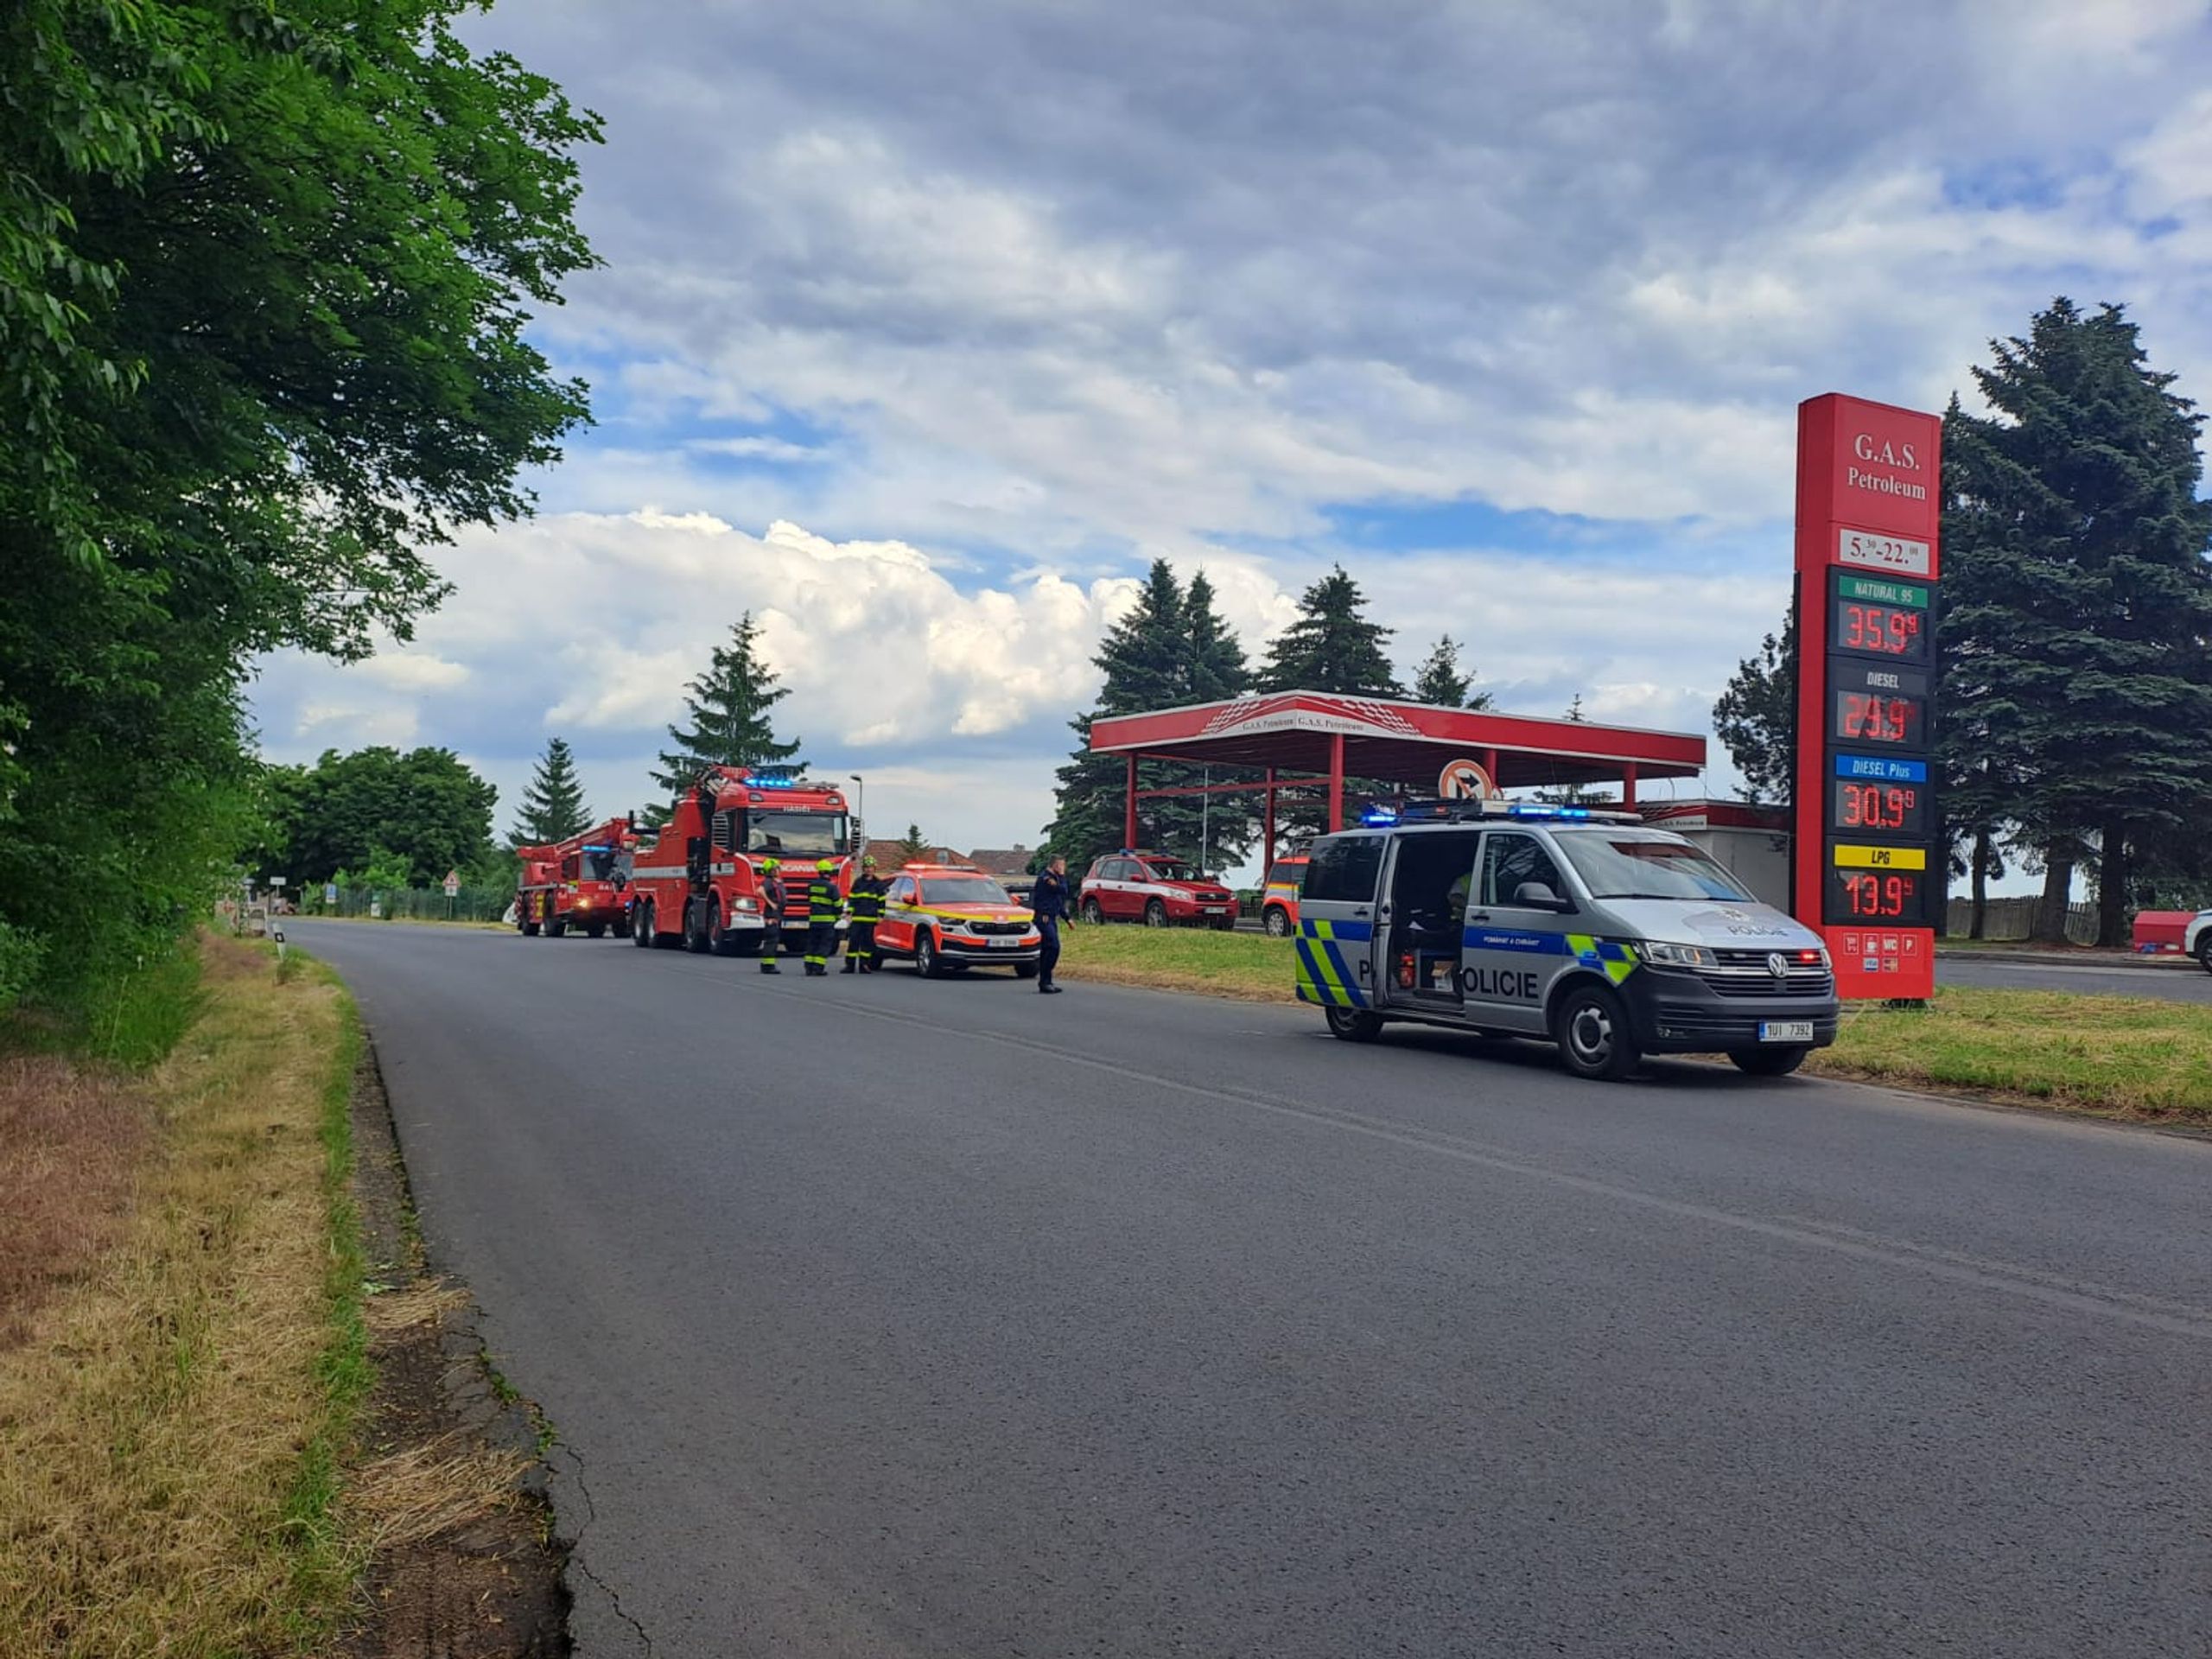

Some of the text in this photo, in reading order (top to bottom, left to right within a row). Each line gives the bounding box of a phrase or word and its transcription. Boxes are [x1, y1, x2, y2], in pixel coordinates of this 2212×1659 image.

[1854, 434, 1920, 470] G.A.S.
[1848, 467, 1926, 500] Petroleum
[1854, 582, 1913, 603] NATURAL 95
[1867, 671, 1899, 689] DIESEL
[1297, 717, 1325, 728] G.A.S.
[1853, 760, 1911, 778] DIESEL Plus
[1872, 850, 1891, 865] LPG
[1884, 938, 1897, 951] WC
